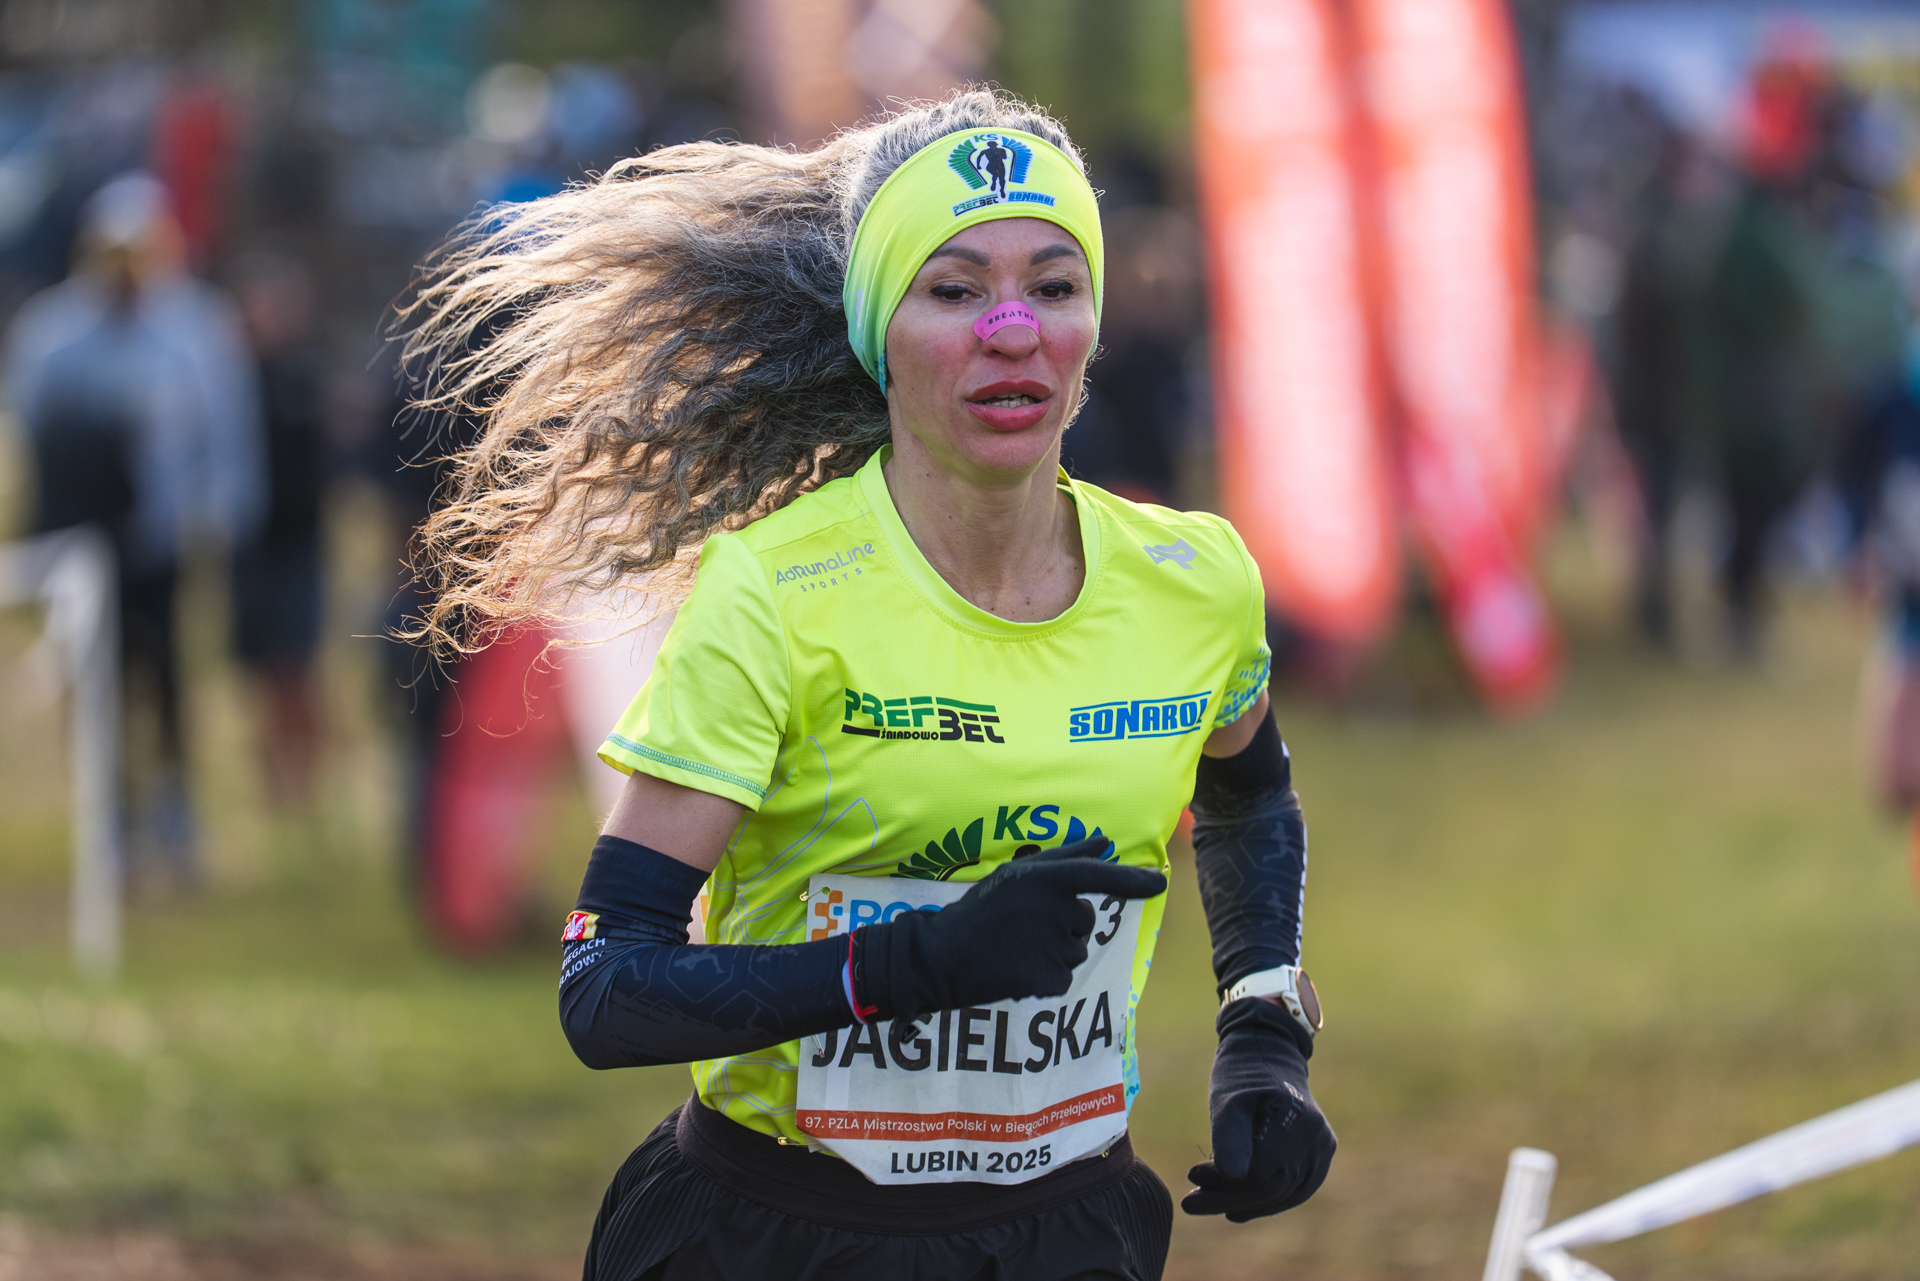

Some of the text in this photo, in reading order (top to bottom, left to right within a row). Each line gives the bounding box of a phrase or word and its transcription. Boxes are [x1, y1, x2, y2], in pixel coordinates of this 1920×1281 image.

[973, 133, 999, 143] KS
[800, 567, 862, 592] SPORTS
[993, 804, 1060, 841] KS
[811, 990, 1112, 1074] JAGIELSKA
[805, 1116, 825, 1129] 97.
[828, 1117, 860, 1130] PZLA
[864, 1118, 944, 1132] Mistrzostwa
[947, 1118, 987, 1132] Polski
[990, 1123, 1002, 1133] w
[1005, 1114, 1049, 1135] Biegach
[891, 1144, 1052, 1174] LUBIN 2025
